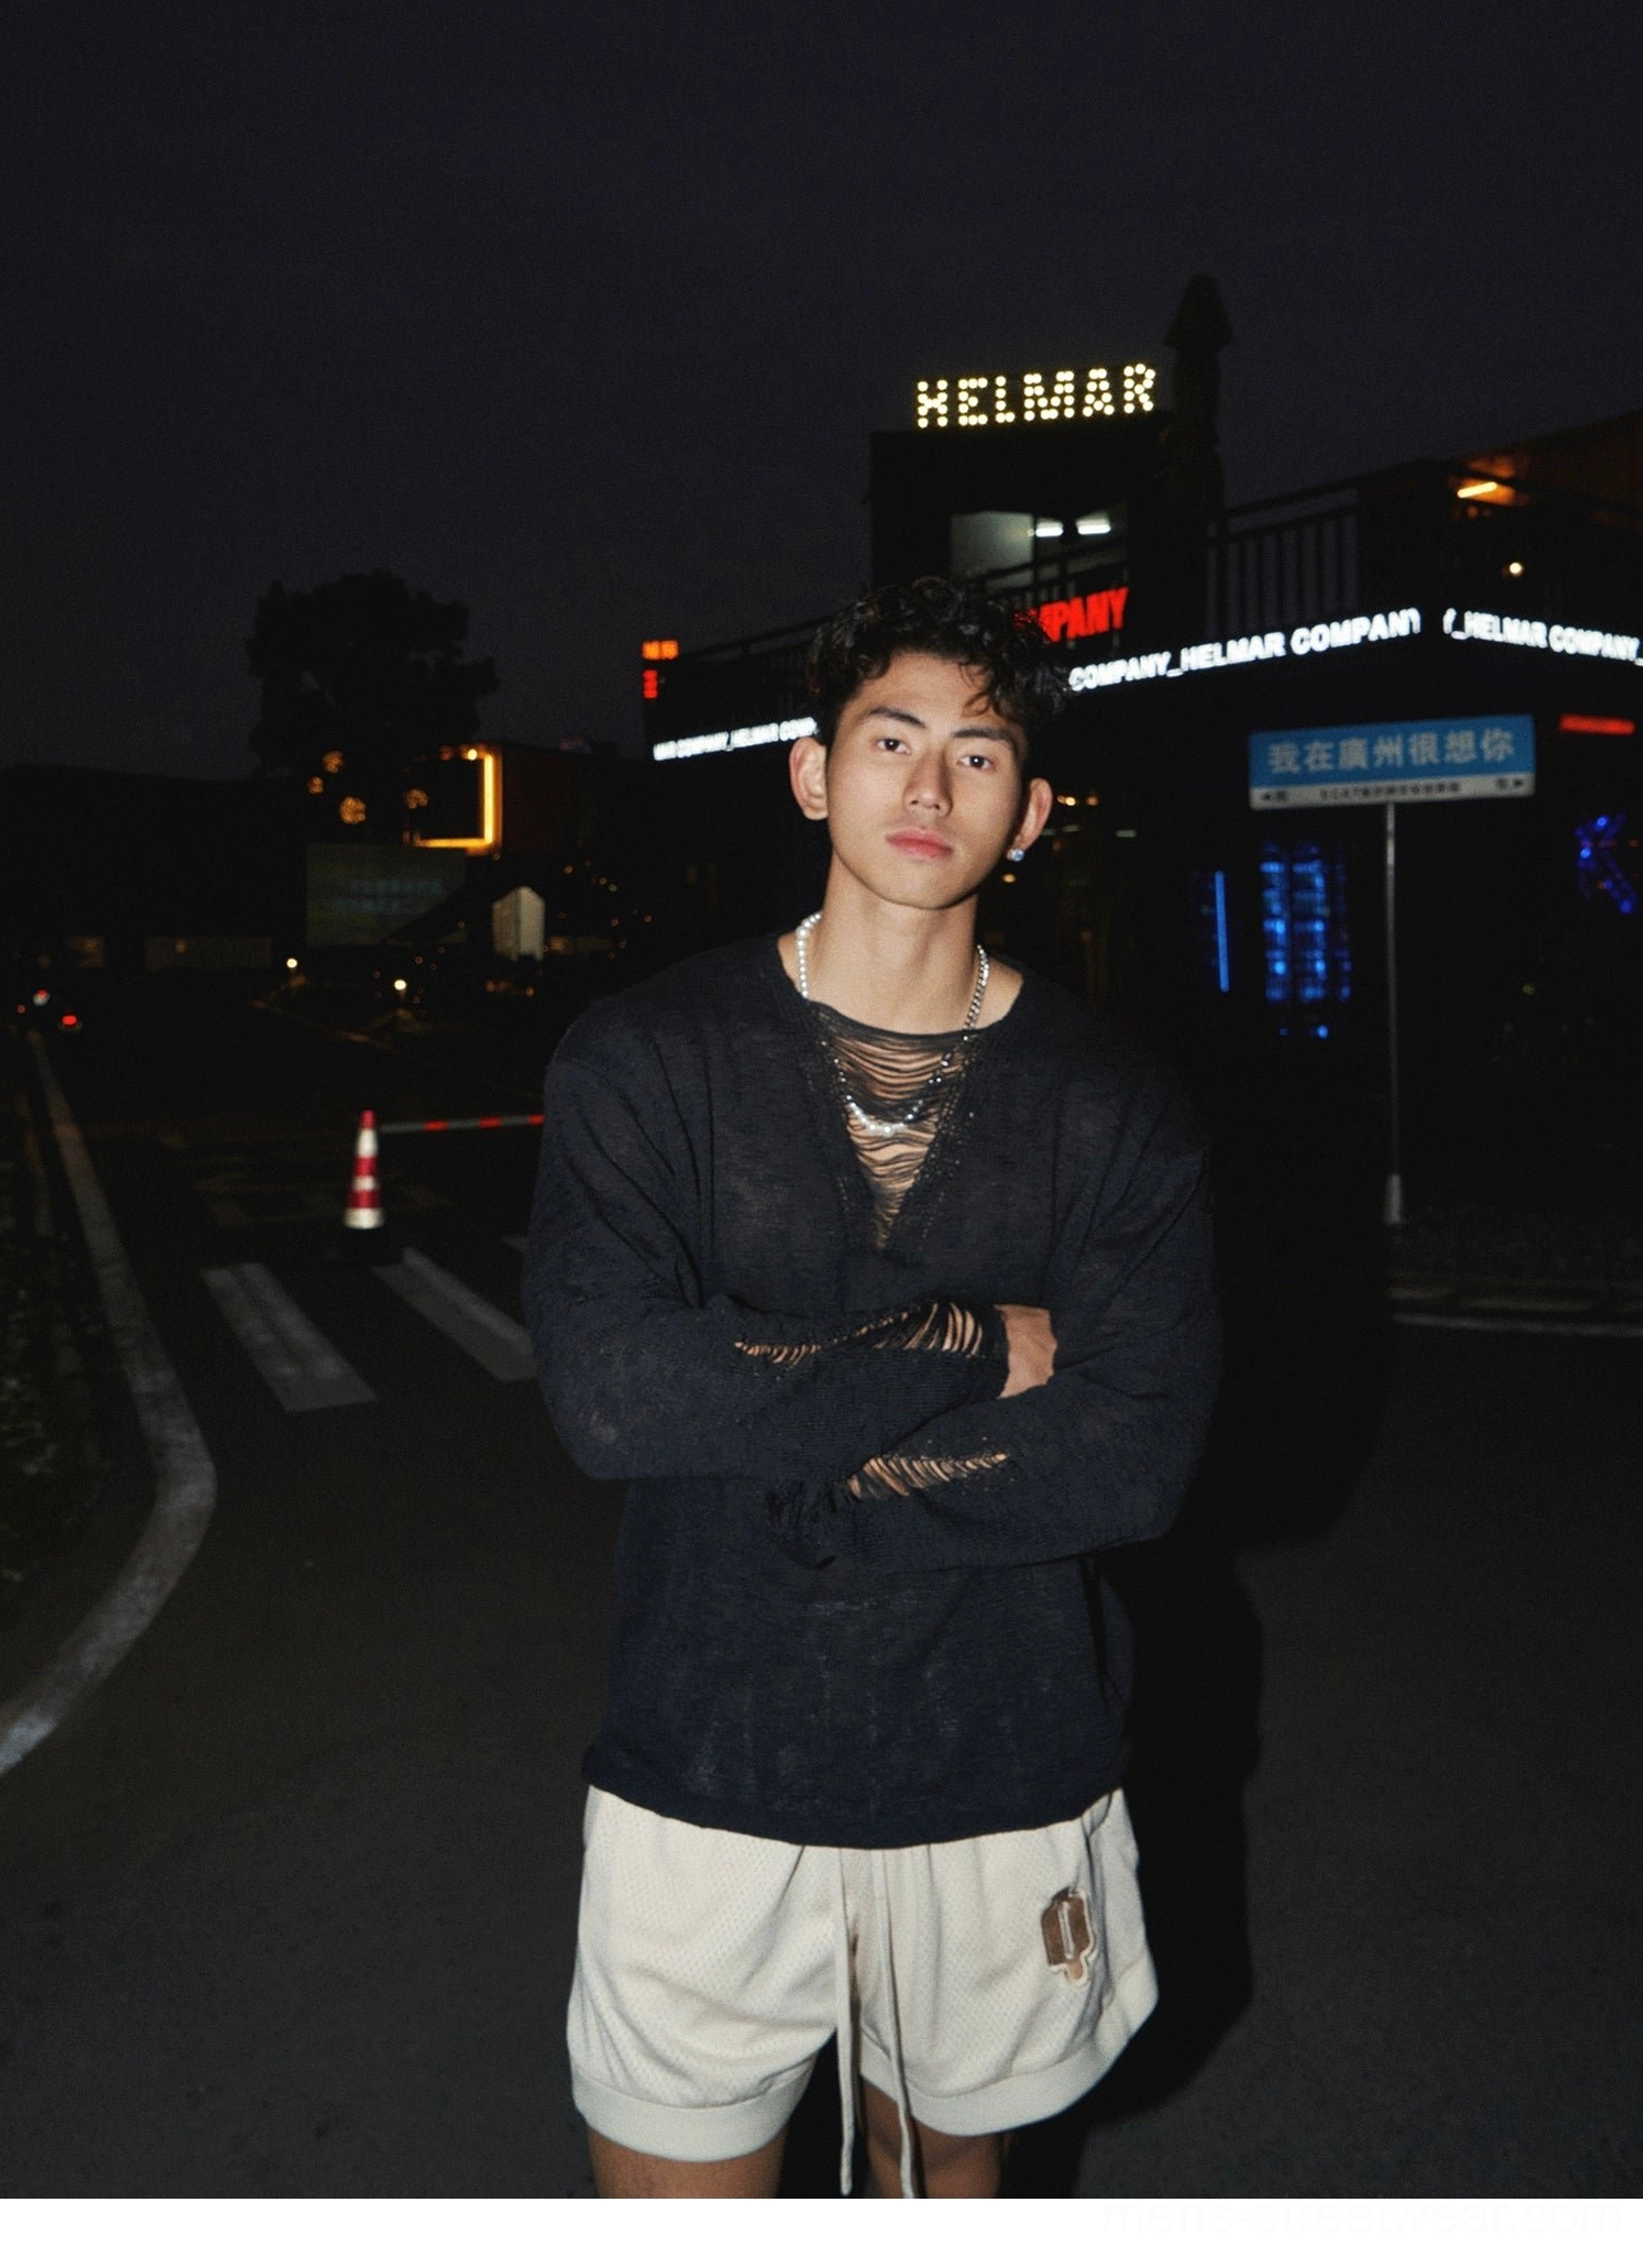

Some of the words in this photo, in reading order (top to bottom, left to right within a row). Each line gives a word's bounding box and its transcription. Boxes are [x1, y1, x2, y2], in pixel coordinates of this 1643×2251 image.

[917, 363, 1156, 428] HELMAR
[1268, 727, 1516, 774] 我在廣州很想你
